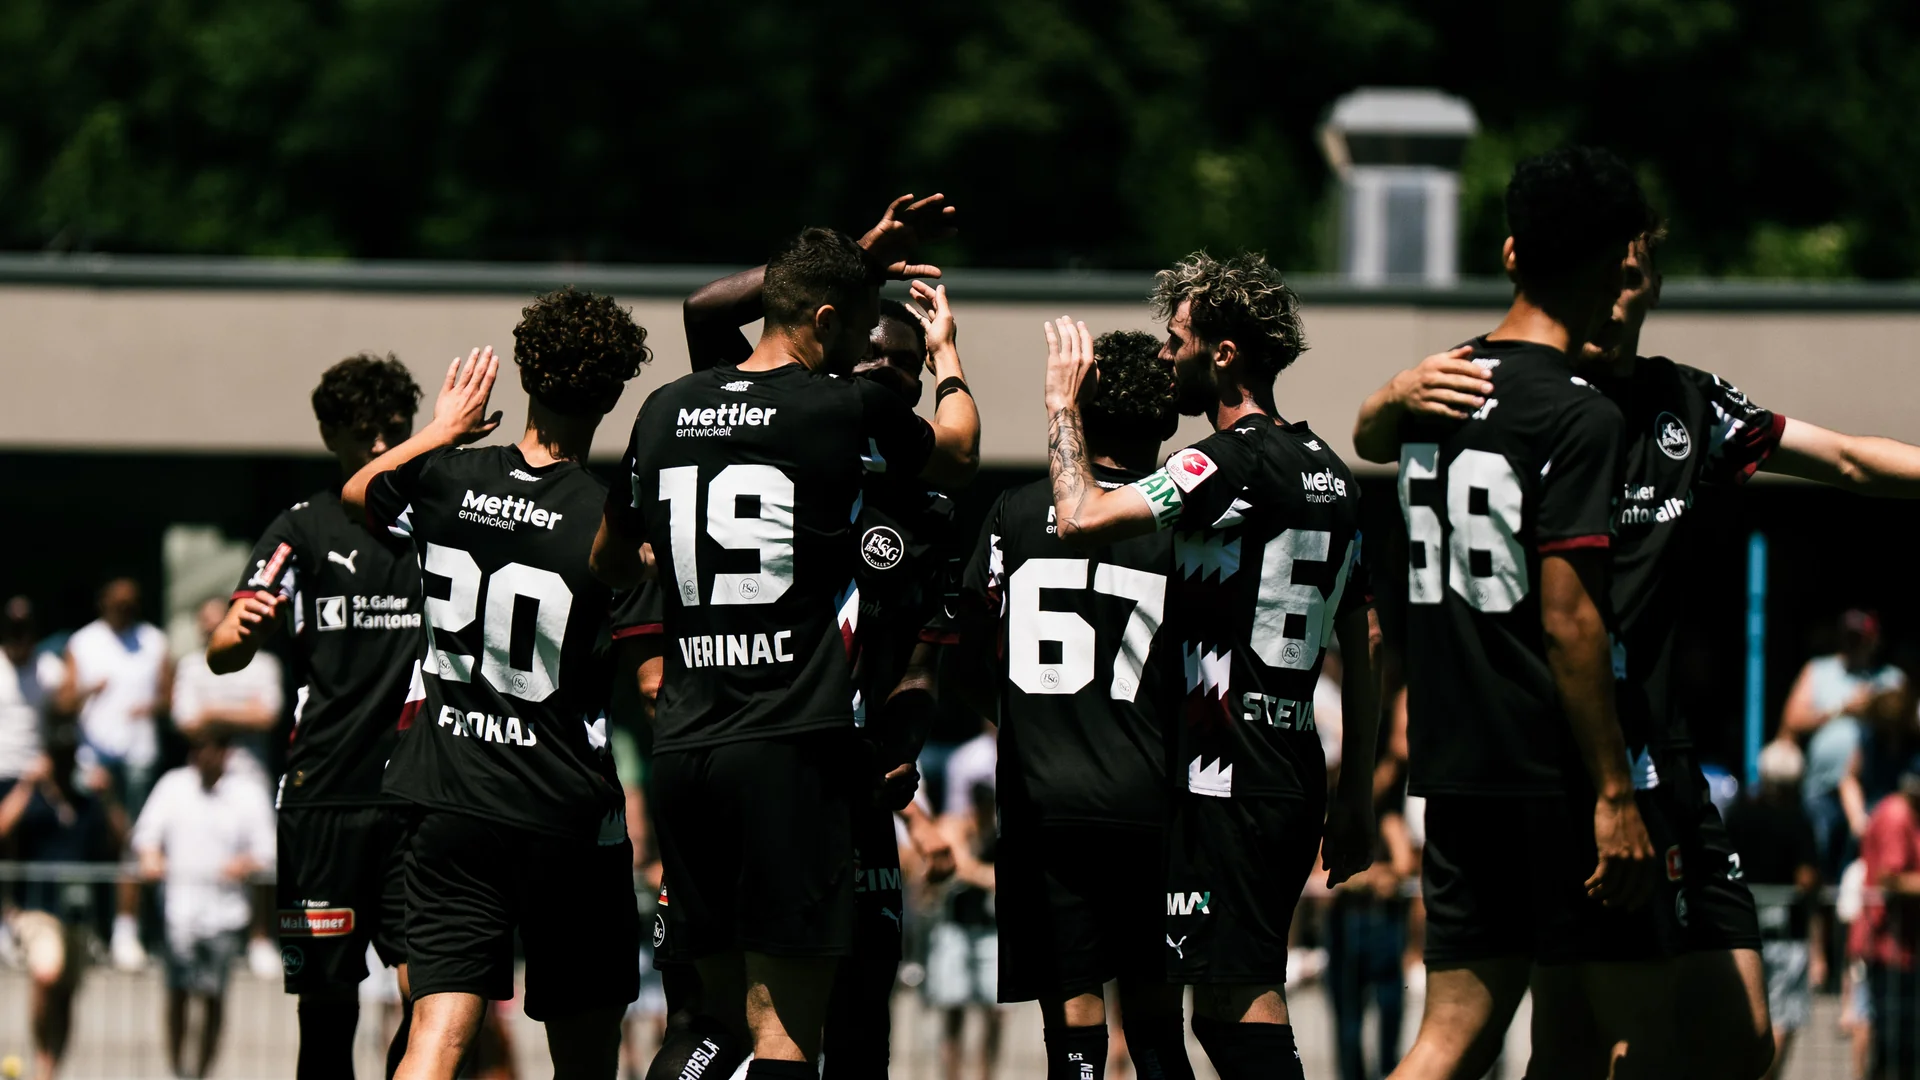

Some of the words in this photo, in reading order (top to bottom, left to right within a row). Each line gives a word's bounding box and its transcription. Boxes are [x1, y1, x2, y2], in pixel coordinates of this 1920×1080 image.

[676, 403, 777, 426] Mettler
[676, 426, 732, 437] entwickelt
[458, 509, 516, 531] entwickelt
[461, 489, 563, 530] Mettler
[1397, 442, 1530, 613] 68
[658, 464, 795, 607] 19
[422, 541, 574, 703] 20
[1009, 558, 1167, 703] 67
[679, 630, 794, 668] VERINAC
[1243, 692, 1314, 732] STEVA
[678, 1037, 720, 1080] HIRSLA
